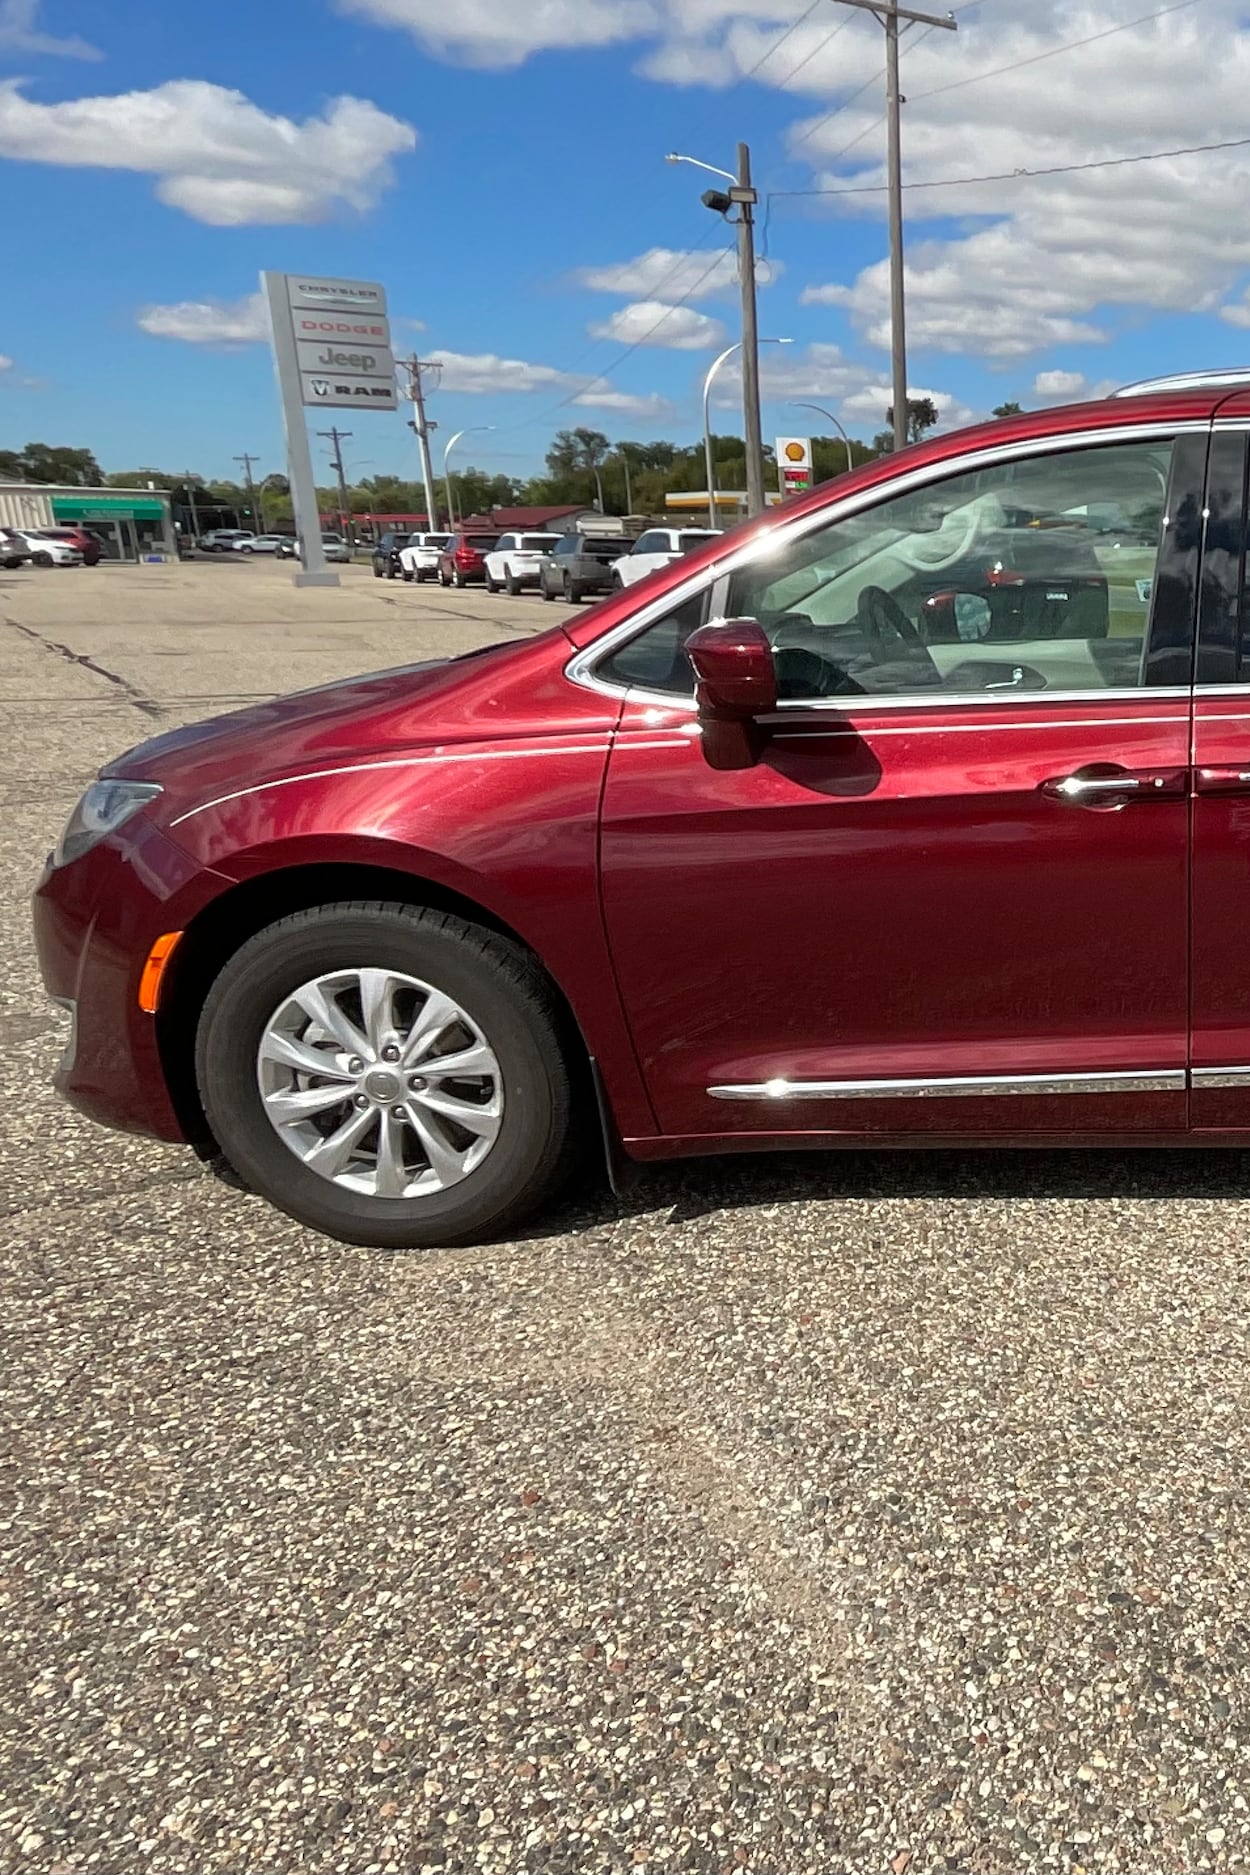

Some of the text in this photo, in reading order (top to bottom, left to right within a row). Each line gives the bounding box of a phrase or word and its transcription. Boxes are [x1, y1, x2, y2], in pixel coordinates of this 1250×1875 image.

[298, 284, 378, 298] CHRYSLER
[301, 320, 384, 336] DODGE
[318, 347, 376, 371] Jeep
[334, 385, 392, 397] RAM
